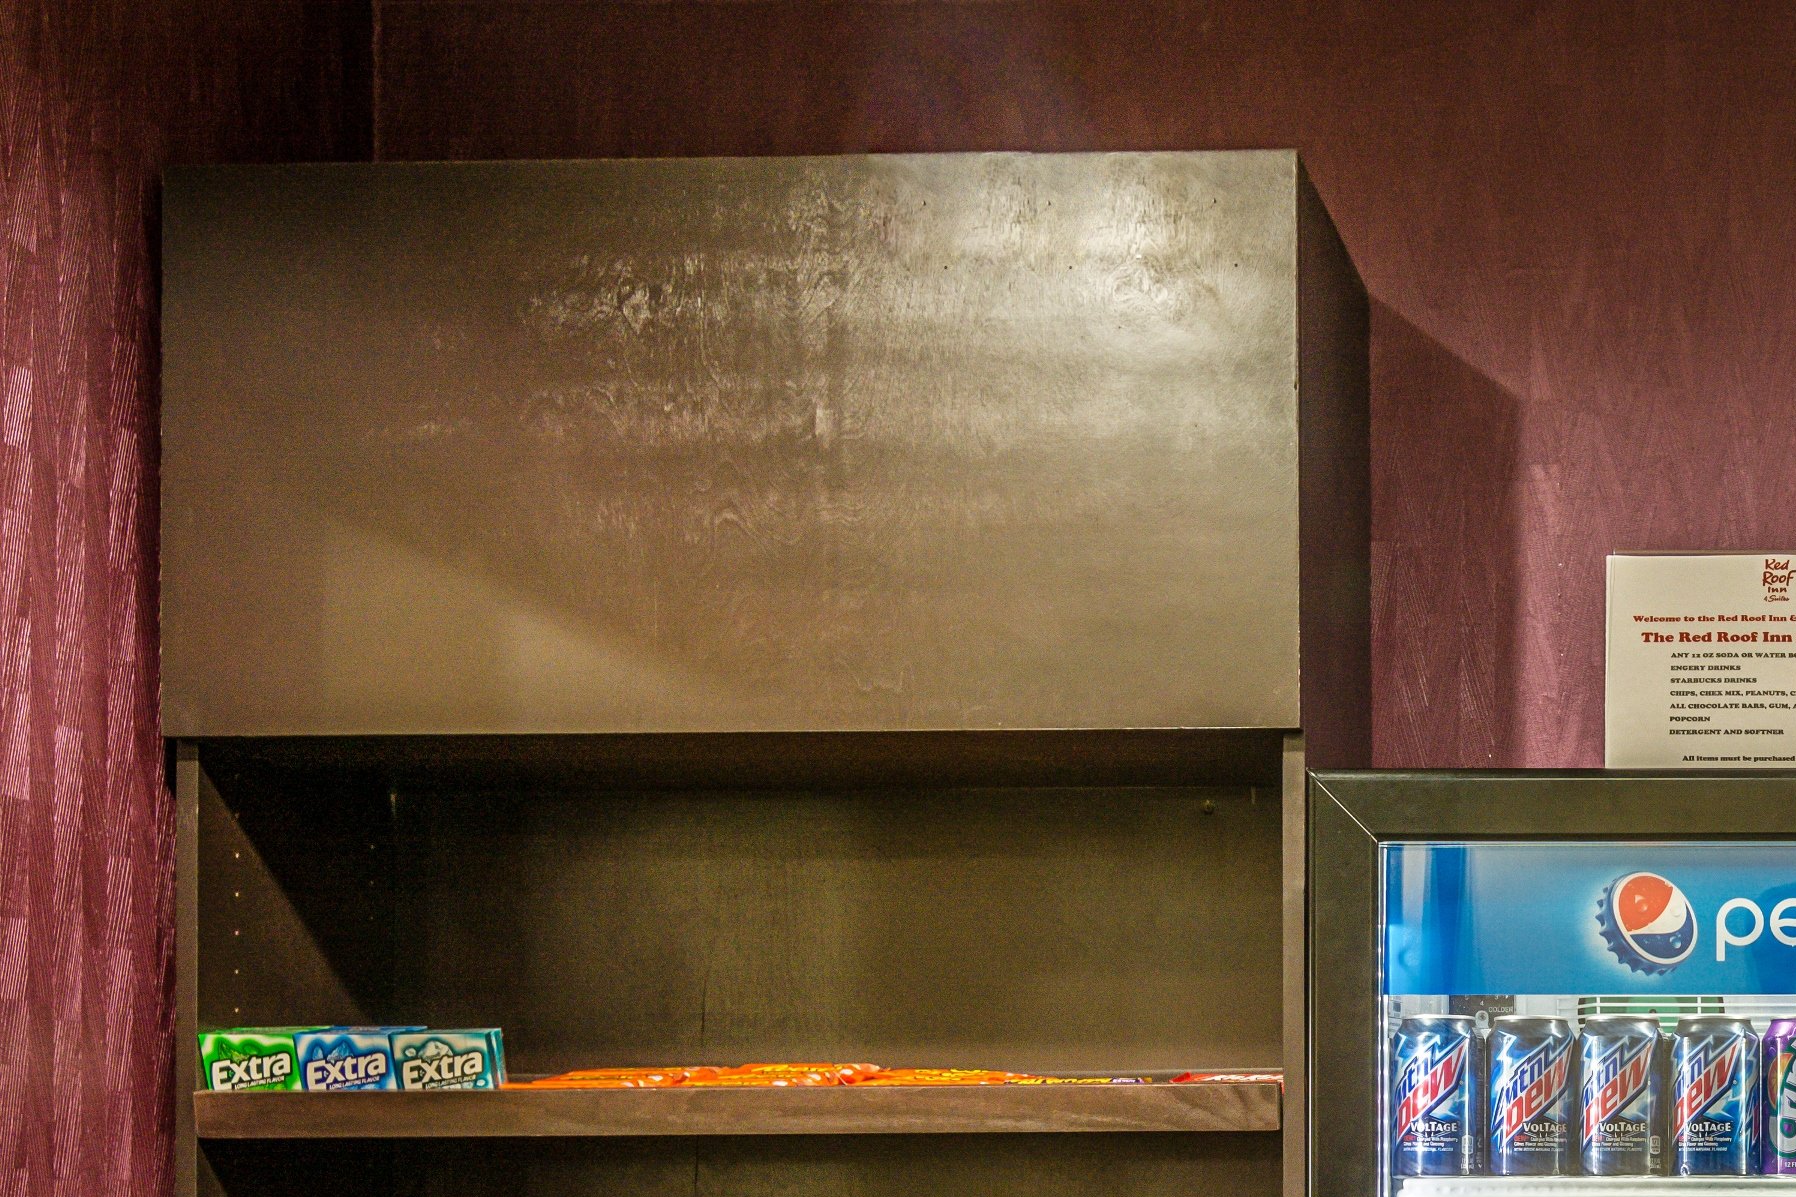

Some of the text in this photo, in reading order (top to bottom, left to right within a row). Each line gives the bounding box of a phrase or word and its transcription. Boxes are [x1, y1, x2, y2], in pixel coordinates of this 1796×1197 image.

[1764, 558, 1790, 571] Red
[1762, 570, 1796, 587] Roof
[1632, 615, 1682, 623] Welcome
[1717, 614, 1739, 622] Red
[1740, 614, 1767, 622] Roof
[1768, 614, 1788, 622] Inn
[1640, 631, 1675, 643] The
[1678, 631, 1713, 643] Red
[1716, 631, 1759, 643] Roof
[1762, 631, 1793, 643] Inn
[1687, 702, 1740, 710] CHOCOLATE
[1668, 728, 1722, 736] DETERGENT
[1753, 755, 1796, 763] purchased
[212, 1052, 291, 1091] Extra
[306, 1052, 387, 1091] Extra
[403, 1052, 482, 1089] Extra
[1523, 1122, 1567, 1133] VOLTAGE
[1599, 1121, 1646, 1132] VOLTAGE
[1686, 1121, 1732, 1132] VOLTAGE
